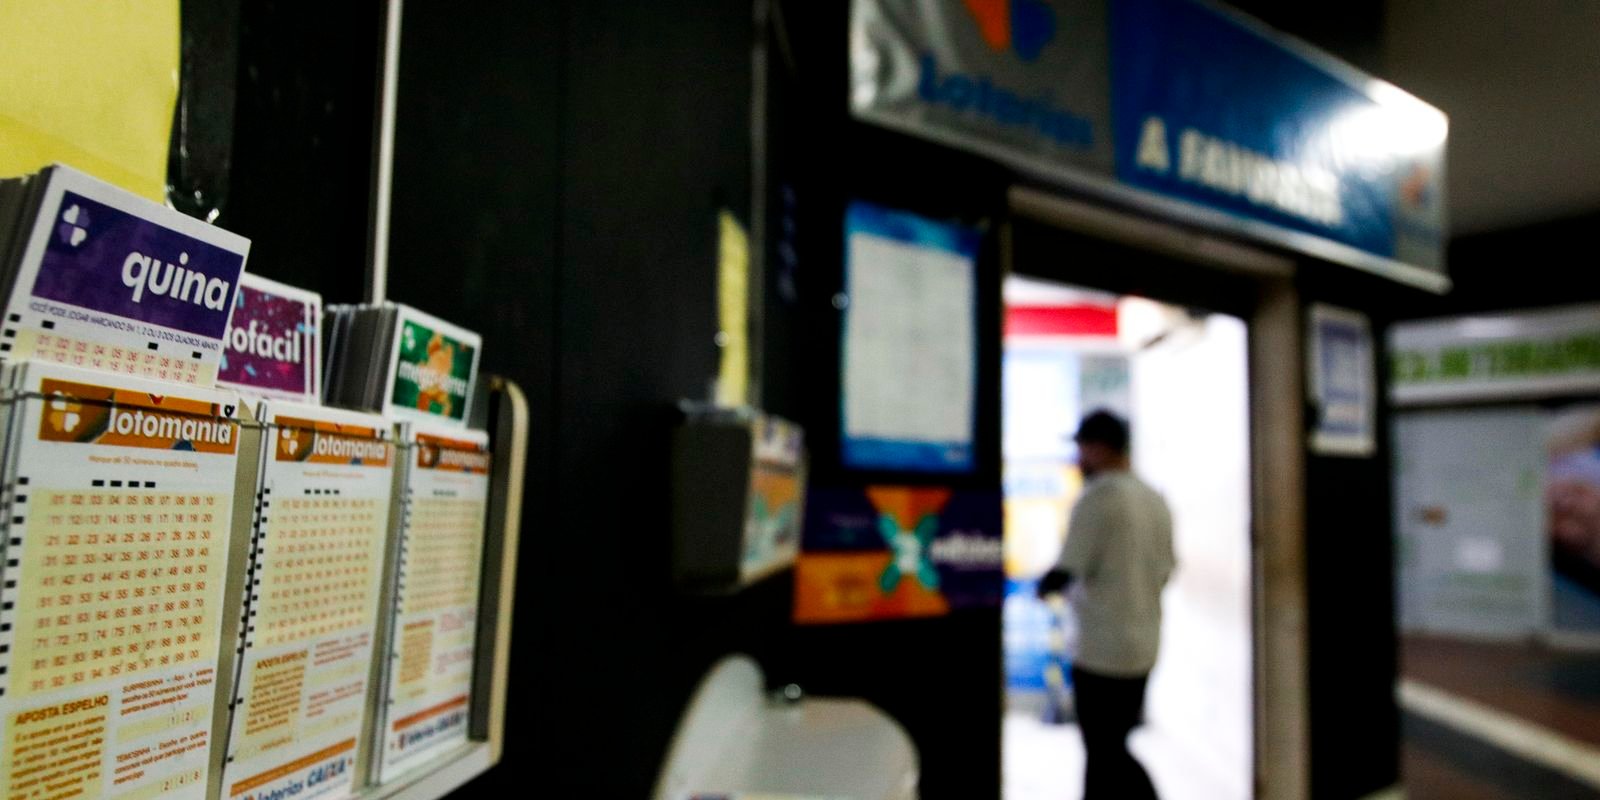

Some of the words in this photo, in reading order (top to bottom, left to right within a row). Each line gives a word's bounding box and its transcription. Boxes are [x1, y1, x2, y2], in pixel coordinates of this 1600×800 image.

[1138, 116, 1169, 174] A
[121, 251, 229, 311] quina
[109, 406, 232, 444] lotomania
[312, 432, 385, 459] lotomania
[110, 495, 120, 504] 04
[128, 496, 137, 504] 05
[145, 496, 154, 504] 06
[108, 515, 118, 523] 14
[126, 514, 135, 523] 15
[143, 514, 152, 523] 16
[204, 514, 211, 522] 20
[106, 534, 116, 543] 24
[124, 533, 133, 542] 25
[141, 533, 150, 541] 26
[202, 531, 209, 539] 30
[103, 553, 114, 562] 34
[121, 552, 131, 561] 35
[139, 551, 148, 560] 36
[200, 548, 208, 556] 40
[101, 572, 112, 581] 44
[119, 571, 129, 580] 45
[137, 569, 146, 578] 46
[198, 565, 206, 573] 50
[99, 591, 110, 601] 54
[117, 590, 127, 599] 55
[135, 588, 144, 597] 56
[197, 582, 204, 590] 60
[97, 611, 108, 620] 64
[115, 609, 125, 618] 65
[133, 606, 142, 615] 66
[195, 599, 203, 607] 70
[95, 630, 106, 639] 74
[114, 628, 123, 637] 75
[131, 625, 140, 634] 76
[193, 616, 201, 624] 80
[93, 650, 104, 659] 84
[112, 647, 121, 656] 85
[129, 644, 138, 653] 86
[192, 633, 200, 641] 90
[91, 669, 102, 678] 94
[110, 666, 120, 675] 95
[127, 662, 137, 671] 96
[190, 650, 198, 658] 00
[15, 705, 59, 725] APOSTA
[62, 694, 108, 715] ESPELHO
[185, 711, 190, 720] 2
[307, 757, 345, 787] CAIXA
[164, 781, 169, 791] 2
